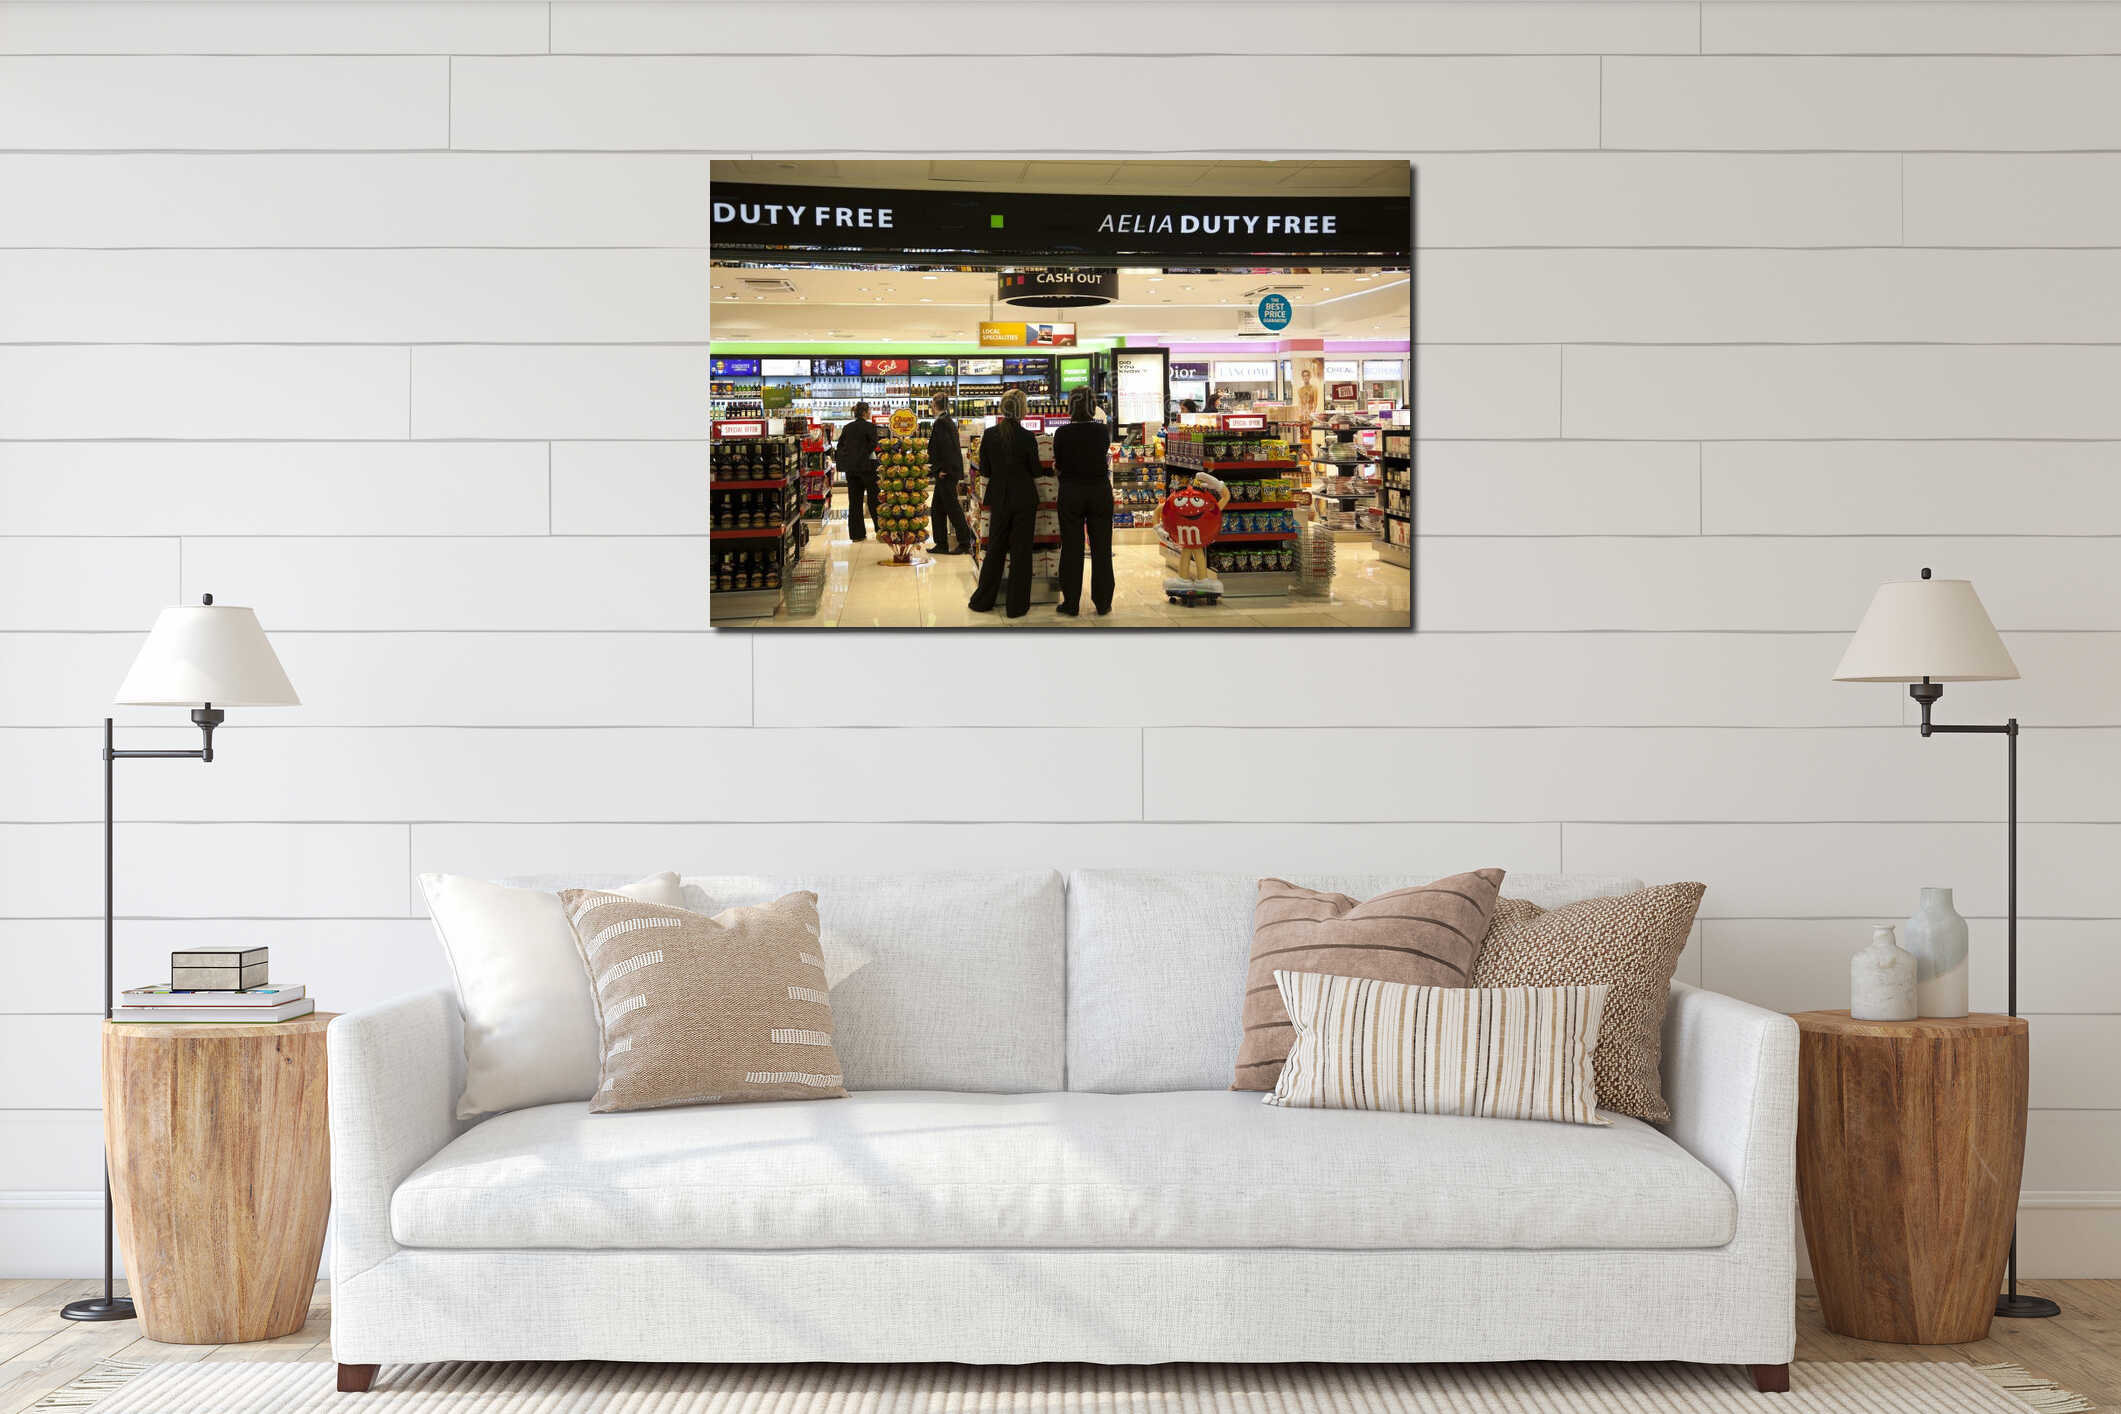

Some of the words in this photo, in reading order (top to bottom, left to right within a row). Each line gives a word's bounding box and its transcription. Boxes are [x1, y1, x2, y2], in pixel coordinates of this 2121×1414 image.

[713, 202, 807, 225] DUTY
[815, 206, 894, 228] FREE
[1097, 214, 1174, 233] AELIA
[1180, 215, 1260, 234] DUTY
[1266, 216, 1337, 234] FREE
[1036, 273, 1074, 284] CASH
[1077, 274, 1102, 285] OUT
[1265, 303, 1285, 311] BEST
[1177, 524, 1203, 546] m
